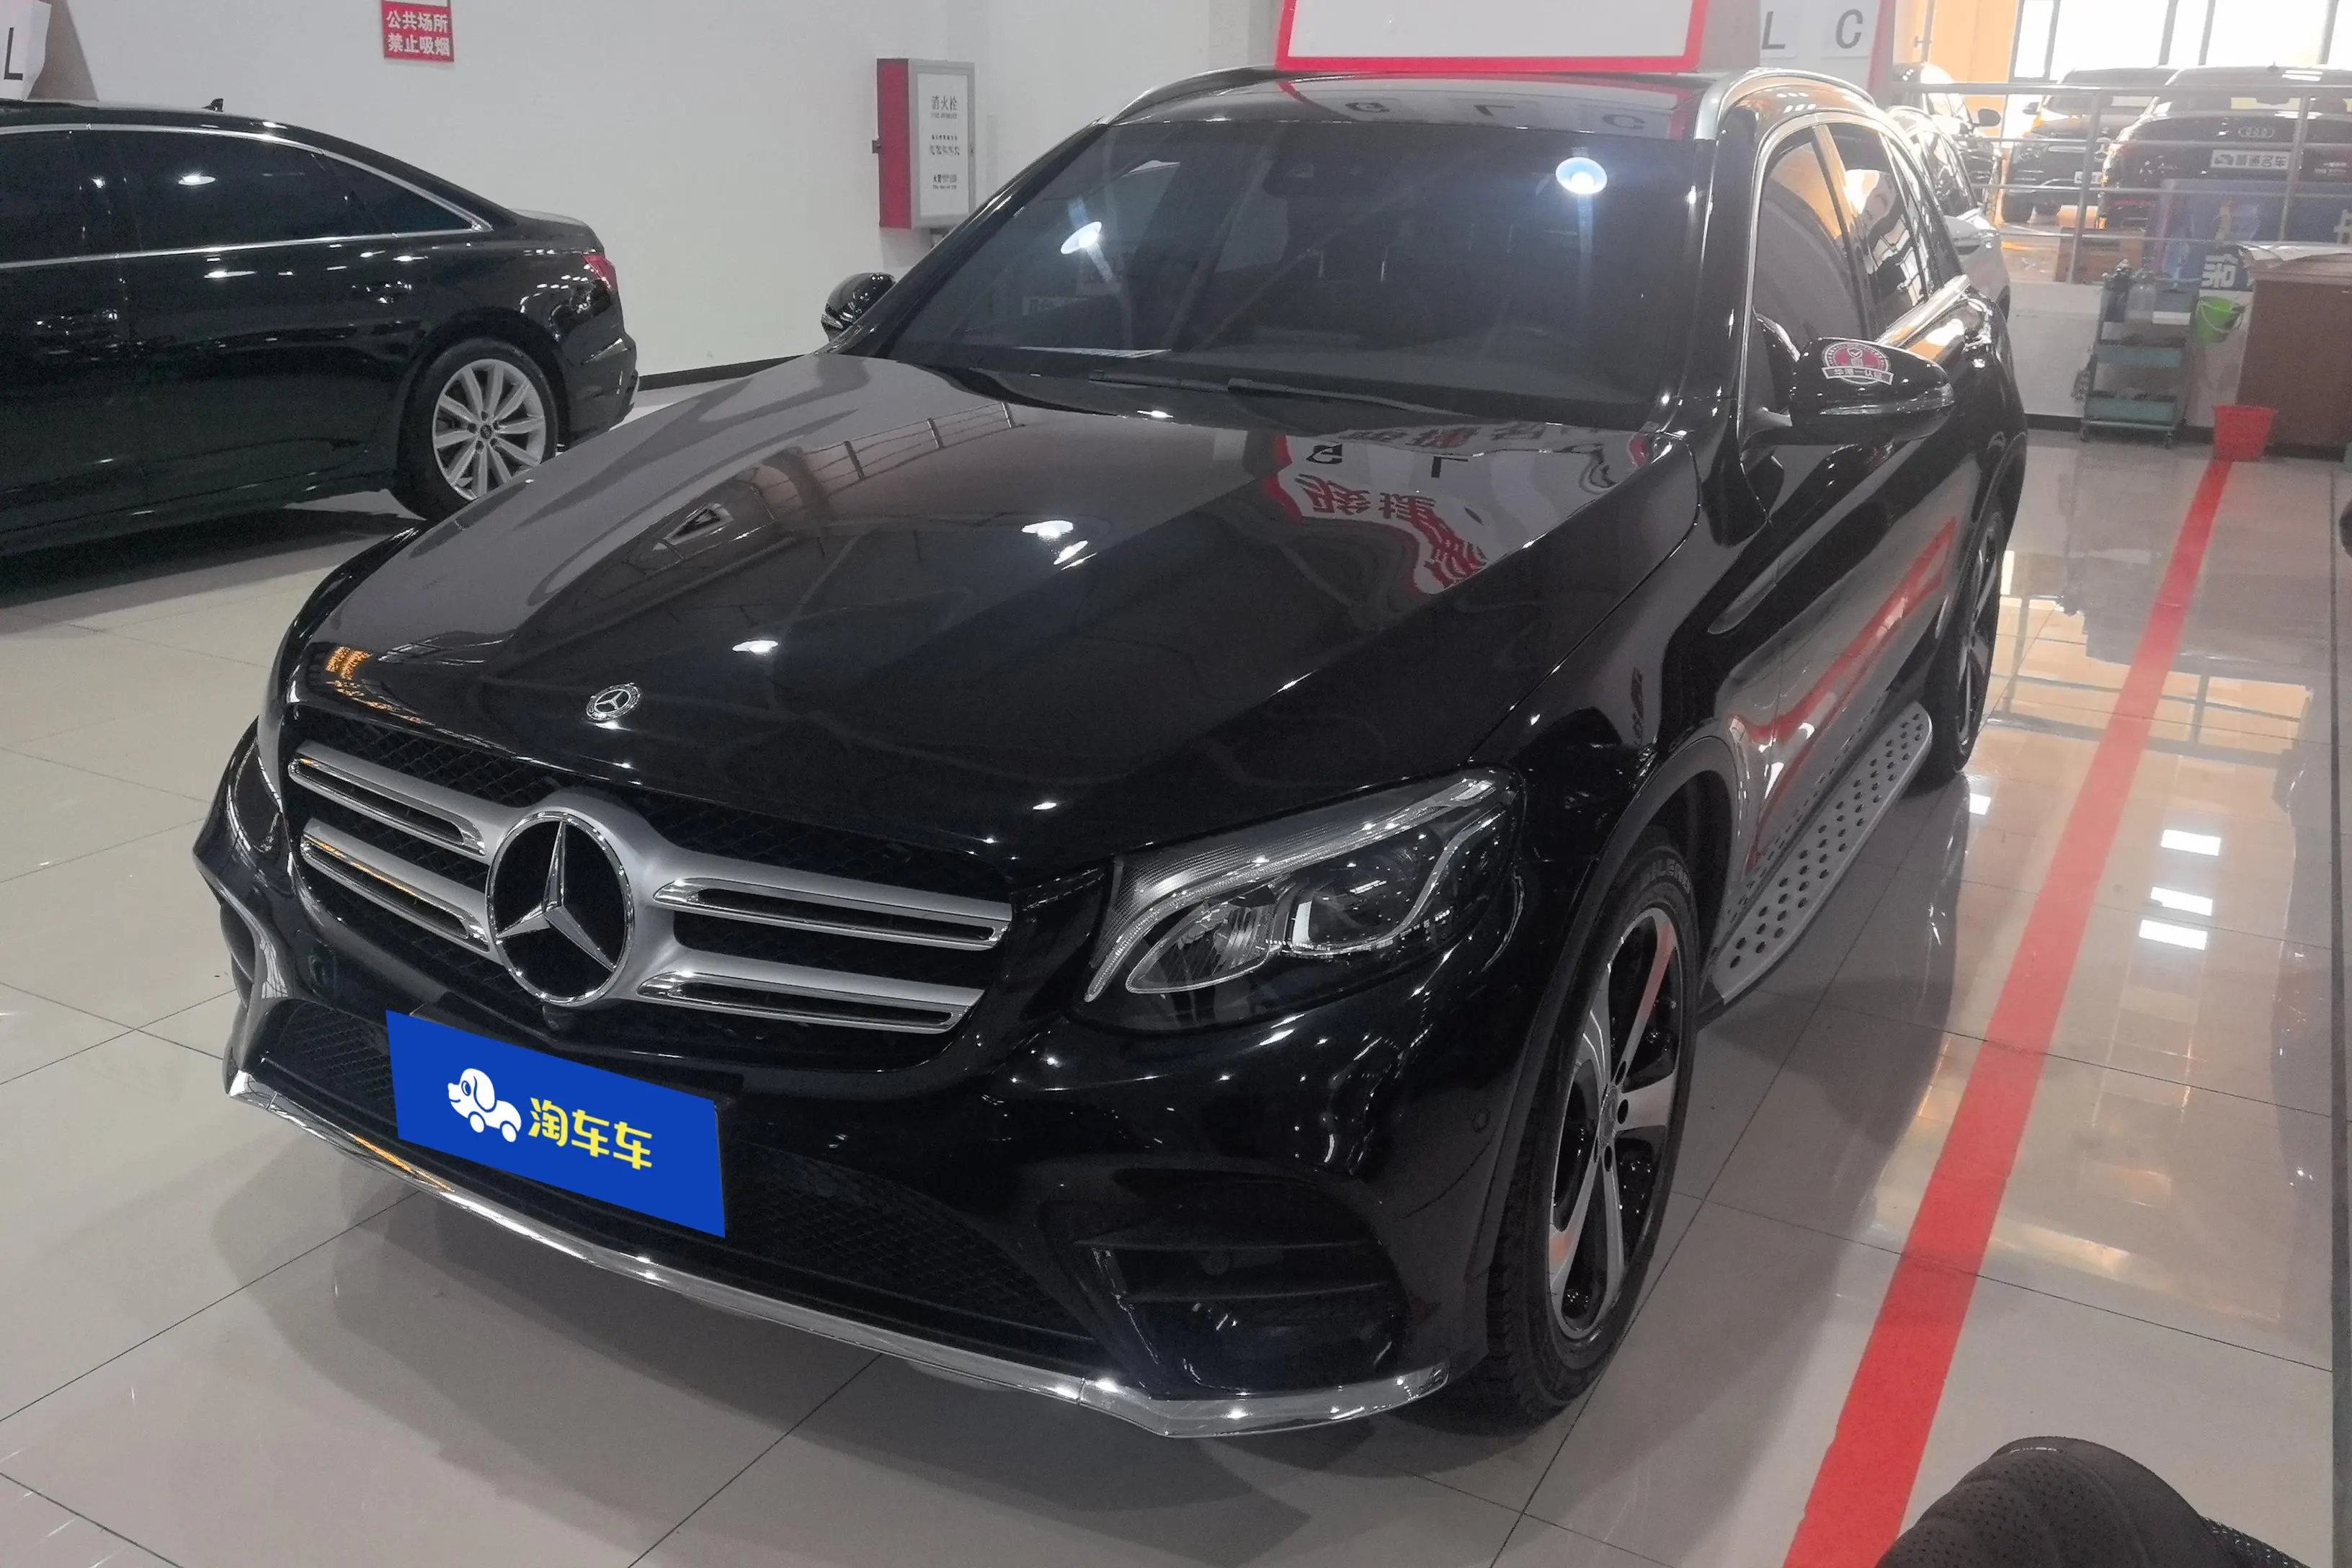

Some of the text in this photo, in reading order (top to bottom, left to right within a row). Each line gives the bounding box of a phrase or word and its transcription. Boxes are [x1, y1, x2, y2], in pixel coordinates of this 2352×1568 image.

[386, 10, 448, 33] 公共场所
[1761, 9, 1863, 50] L C
[4, 27, 24, 81] L
[386, 32, 450, 57] 禁止吸烟
[930, 95, 958, 111] 消火栓
